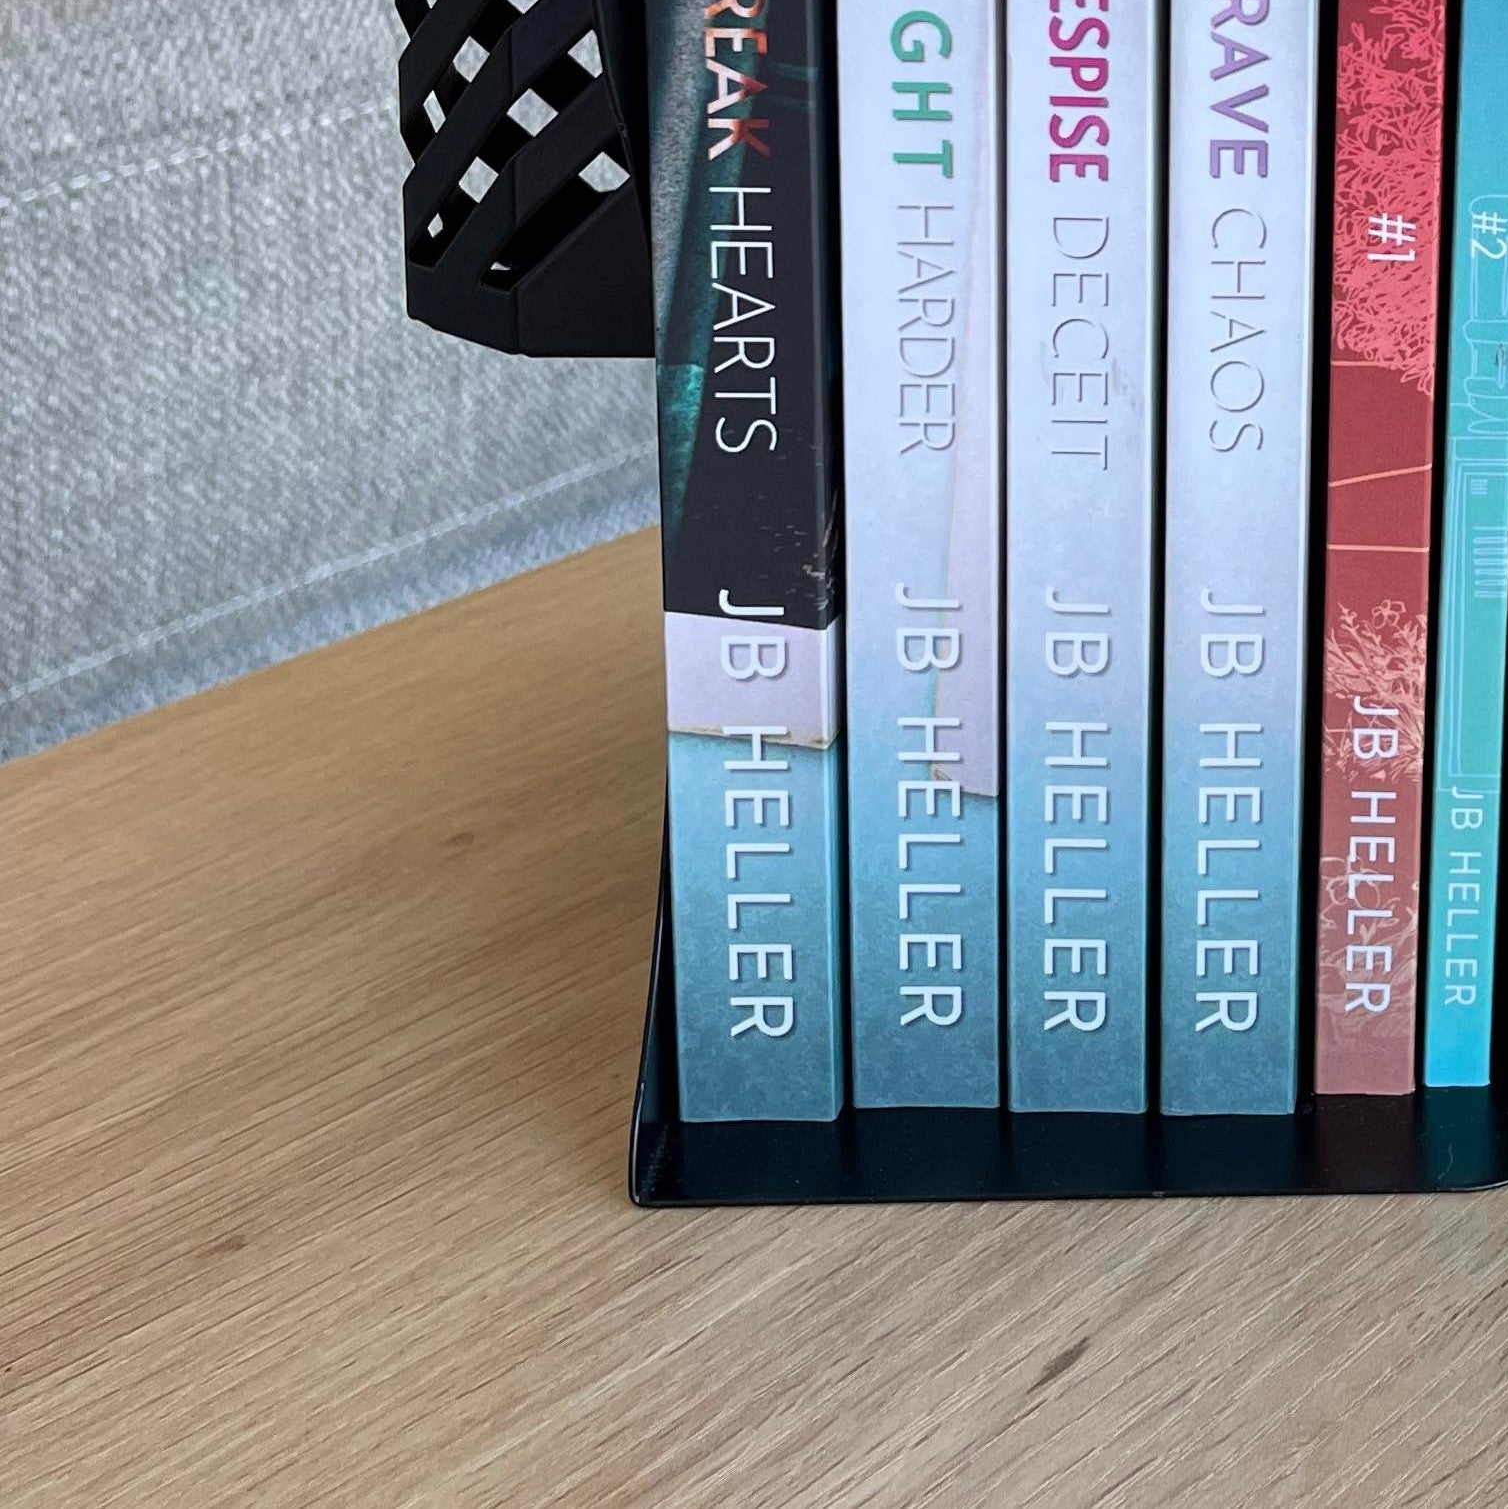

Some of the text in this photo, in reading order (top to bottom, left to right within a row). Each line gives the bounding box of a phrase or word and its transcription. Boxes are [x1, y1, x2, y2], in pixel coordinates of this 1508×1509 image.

[708, 186, 777, 452] HEARTS
[898, 204, 956, 453] HARDER
[1052, 216, 1109, 470] DECEIT
[1209, 208, 1267, 452] CHAOS
[1367, 212, 1416, 262] #1
[1471, 210, 1508, 260] #2
[718, 589, 796, 1038] JB HELLER
[896, 582, 964, 1027] JB HELLER
[1044, 586, 1111, 1033] JB HELLER
[1195, 587, 1265, 1033] JB HELLER
[1344, 694, 1400, 1014] JB HELLER
[1443, 786, 1484, 1007] JB HELLER
